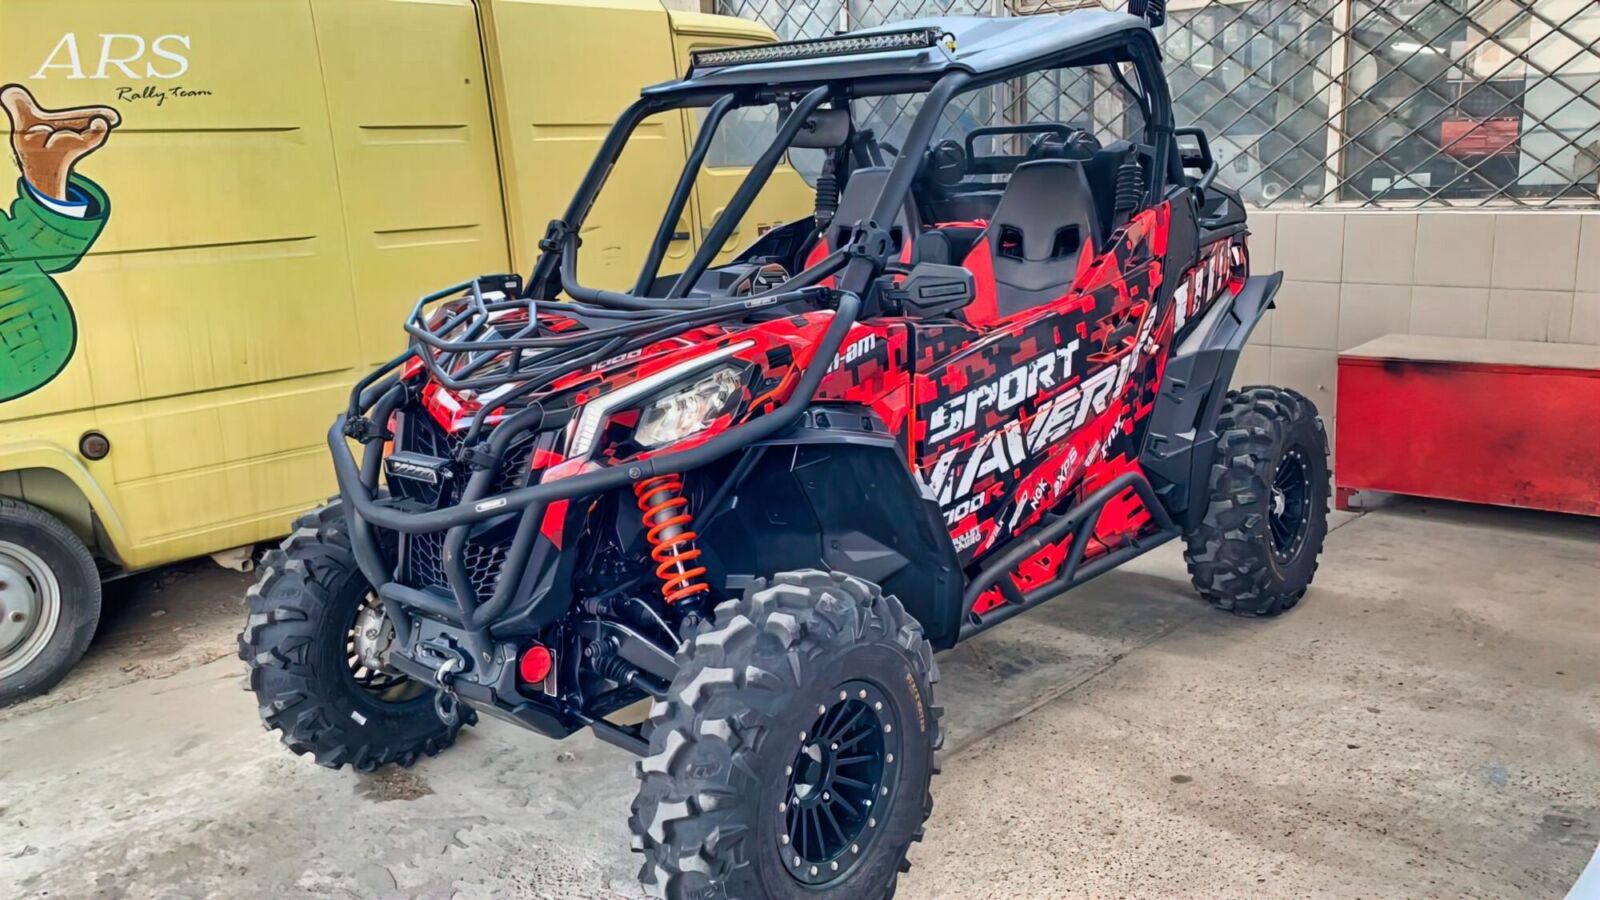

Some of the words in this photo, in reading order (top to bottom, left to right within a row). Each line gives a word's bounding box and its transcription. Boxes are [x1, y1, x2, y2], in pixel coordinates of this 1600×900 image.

[29, 32, 191, 80] ARS
[116, 86, 166, 107] Rally
[168, 86, 213, 97] Team
[928, 338, 1080, 446] SPORT
